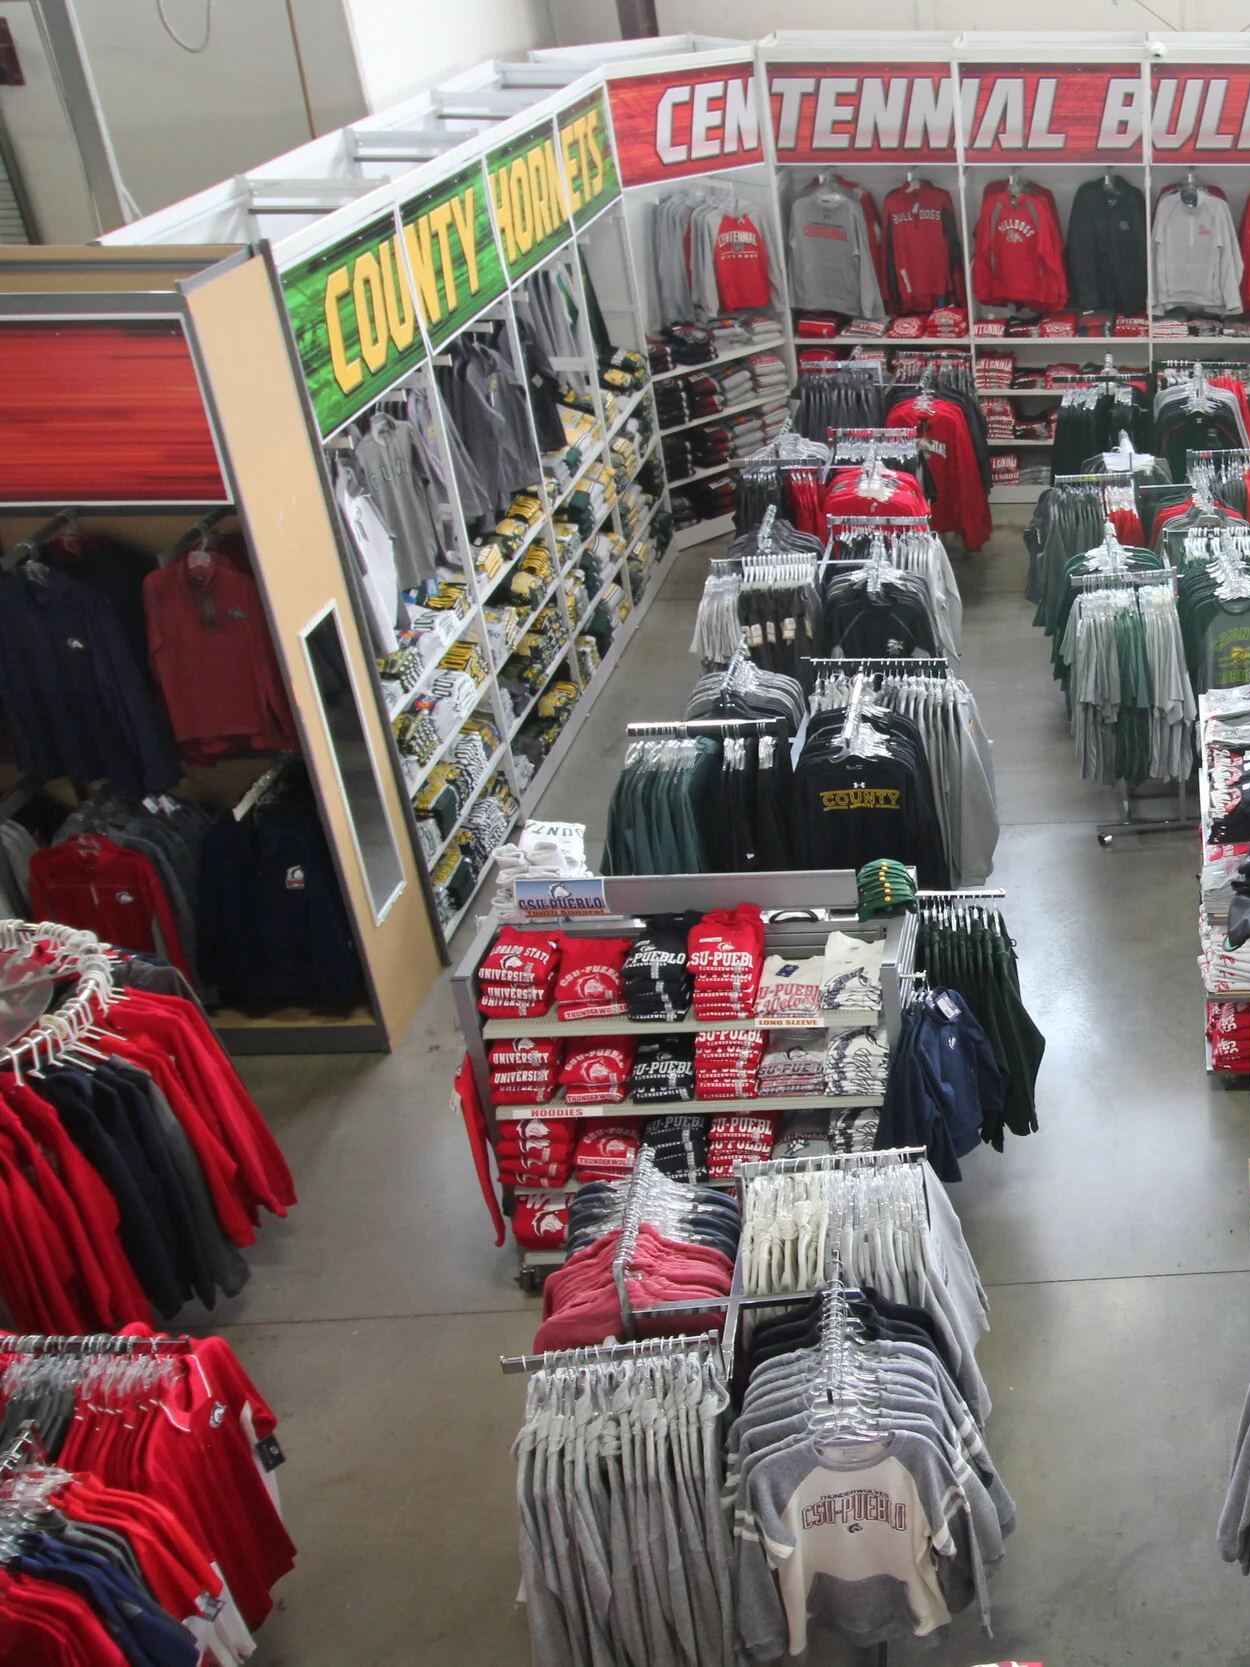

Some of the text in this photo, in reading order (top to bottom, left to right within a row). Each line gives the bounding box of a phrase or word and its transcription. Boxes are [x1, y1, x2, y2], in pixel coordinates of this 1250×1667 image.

[656, 77, 1067, 165] CENTENNIAL
[325, 110, 605, 394] COUNTY HORNETS
[822, 792, 900, 807] COUNTY
[519, 898, 606, 911] CSU-PUEBLO
[531, 1108, 583, 1118] HOODIES
[820, 1489, 890, 1501] THUNDERWOLVES
[802, 1495, 907, 1532] CSU-PUEBLO
